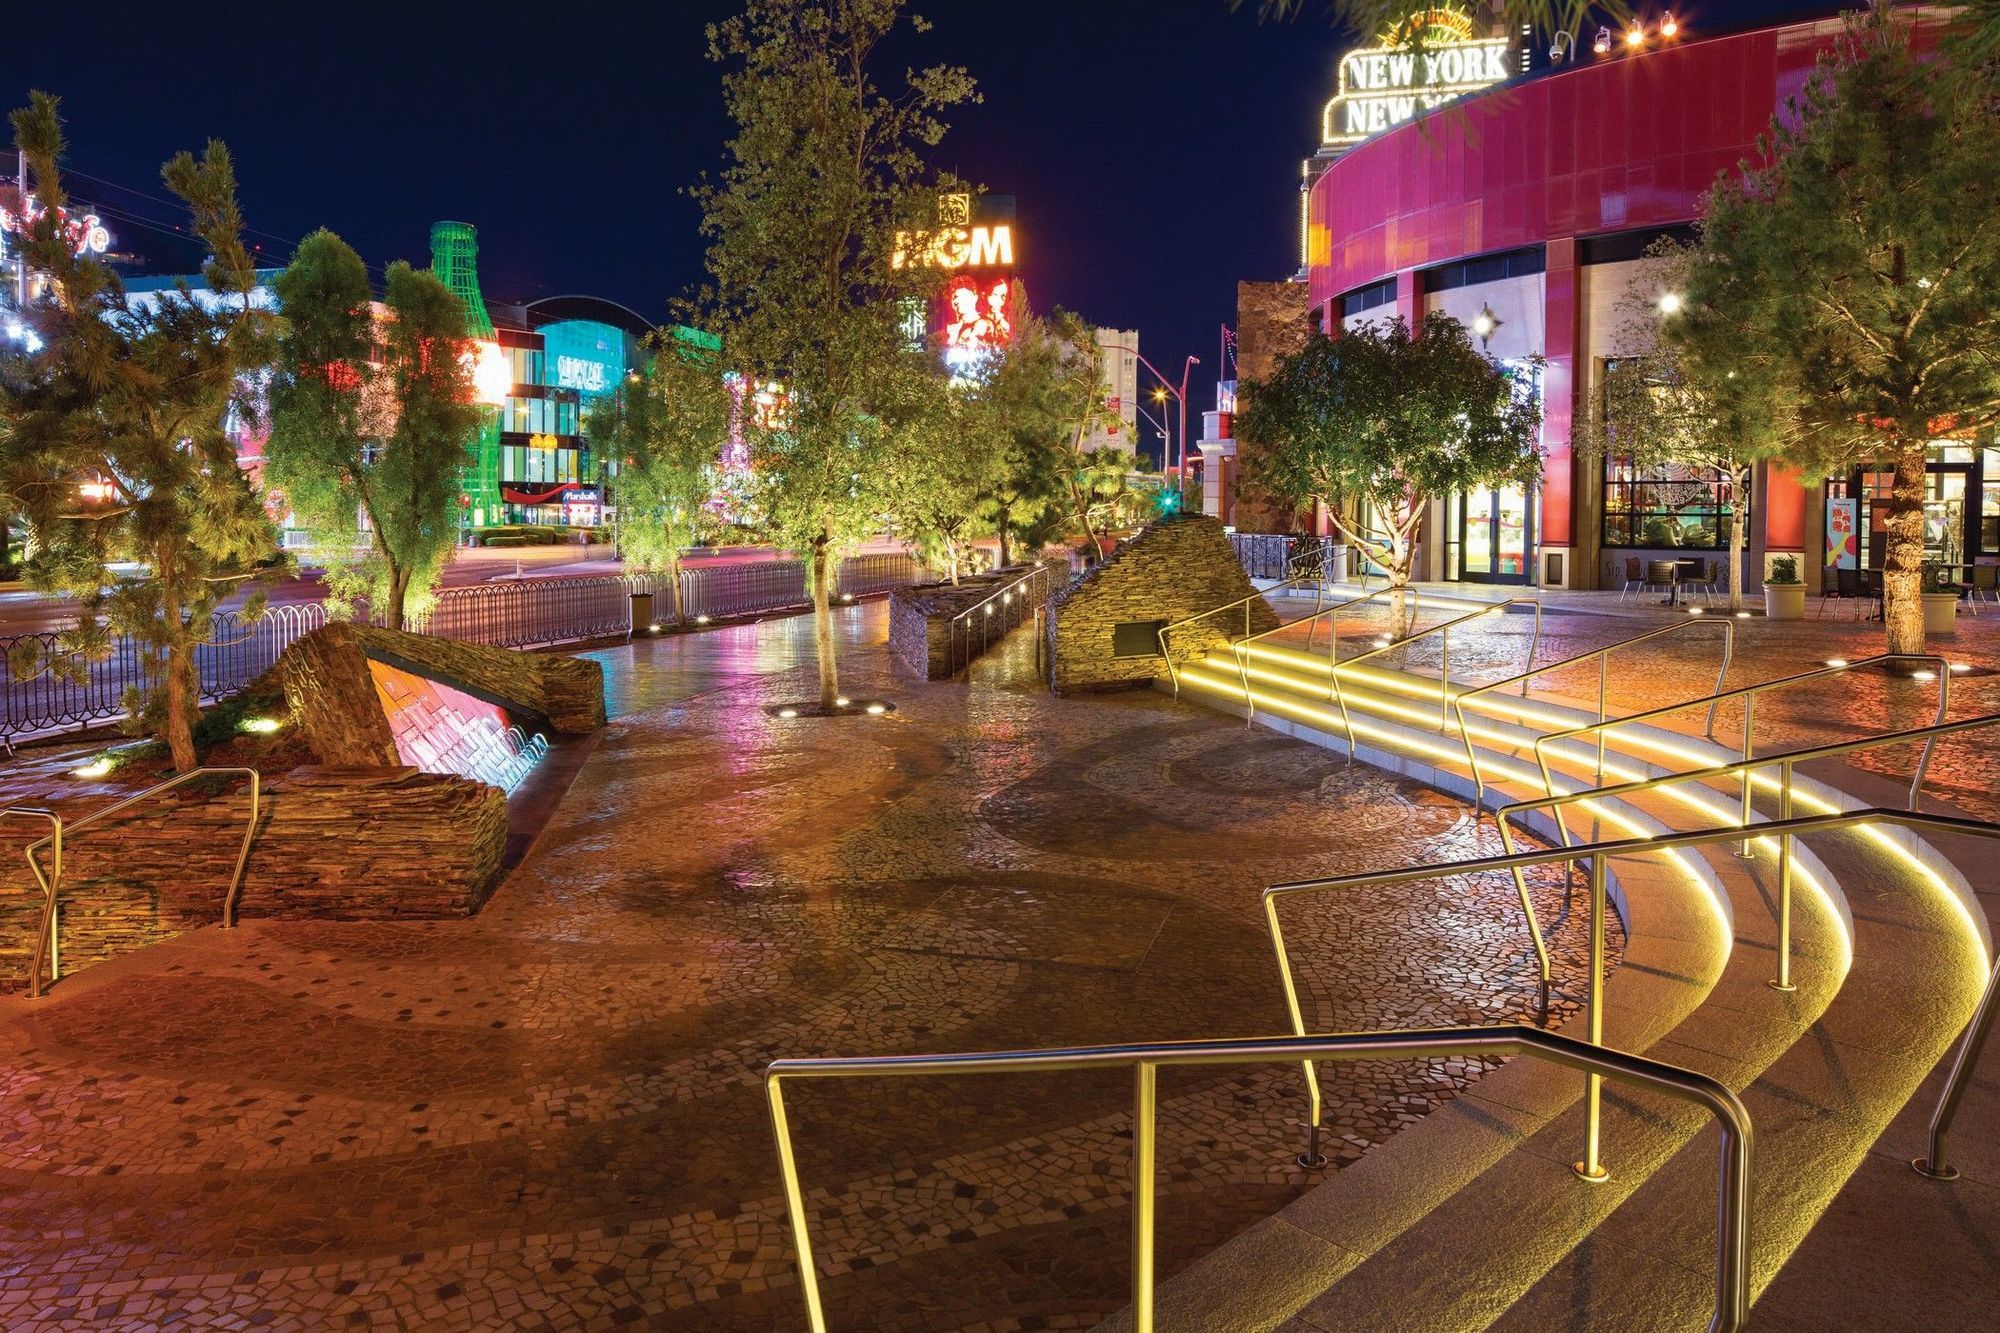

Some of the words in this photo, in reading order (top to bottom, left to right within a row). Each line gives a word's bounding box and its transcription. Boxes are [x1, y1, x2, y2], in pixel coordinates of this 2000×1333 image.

[1348, 52, 1414, 89] NEW
[1422, 45, 1508, 84] YORK
[1346, 96, 1416, 132] NEW
[563, 491, 598, 501] Marshalls
